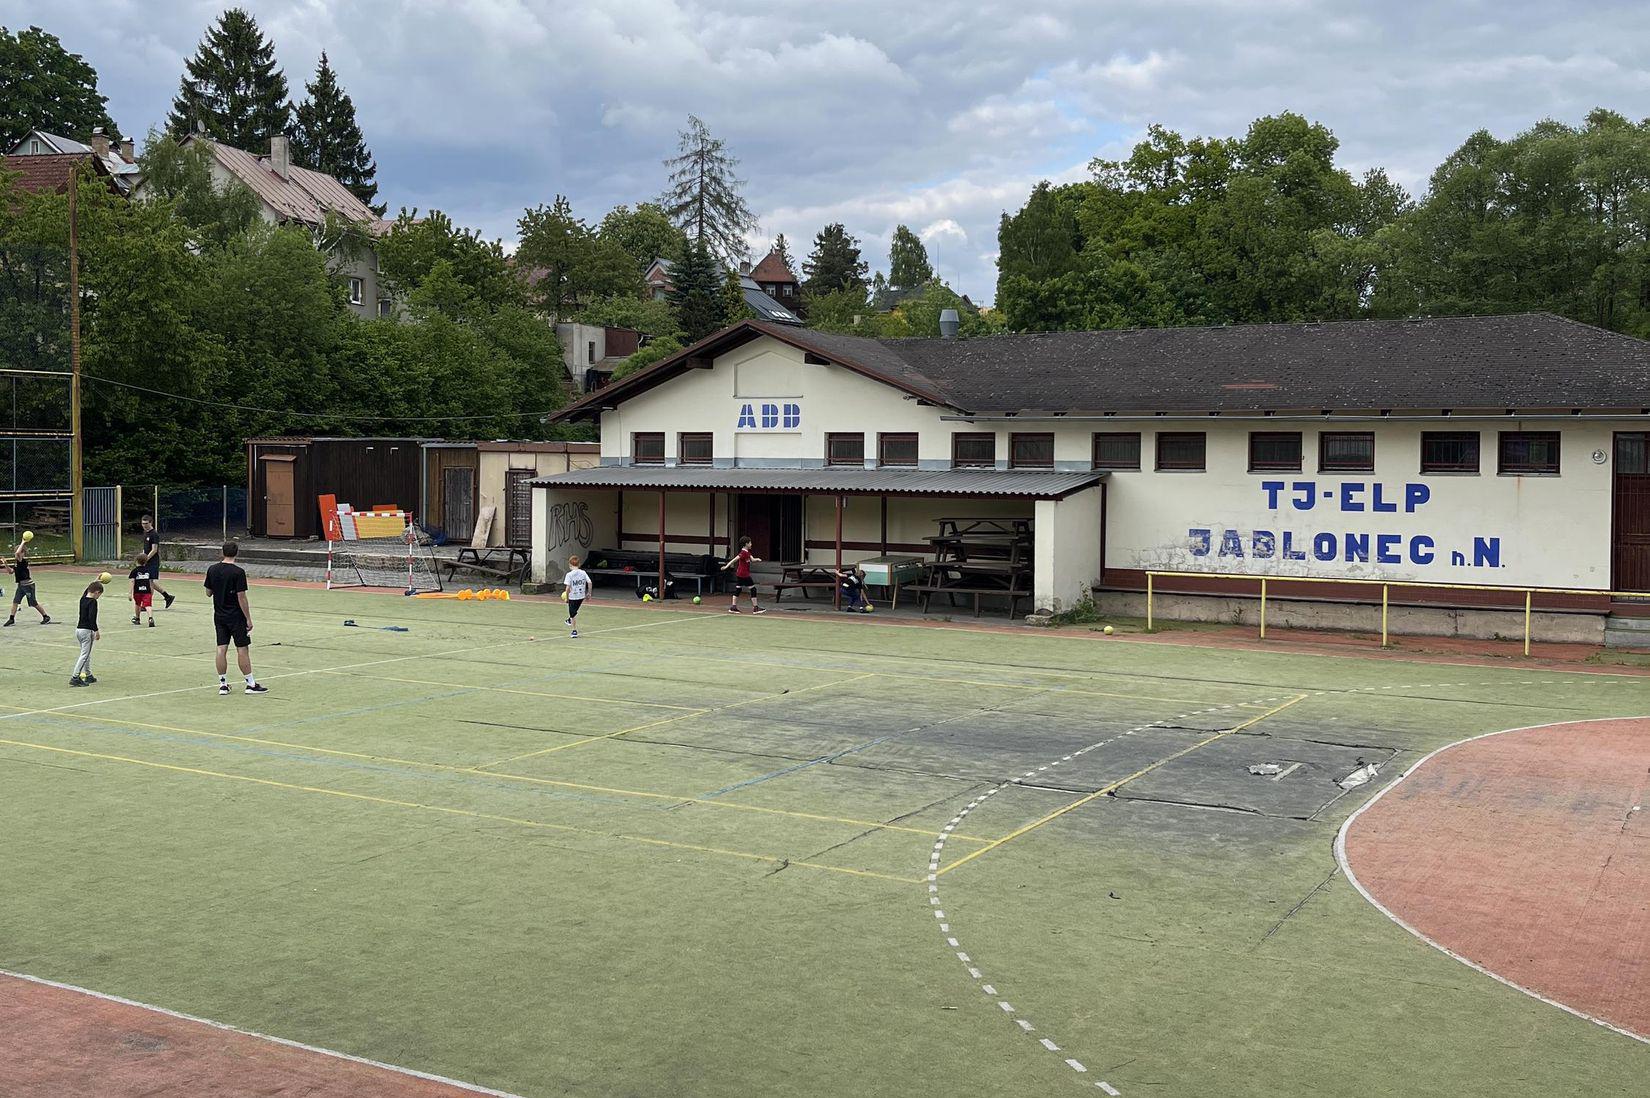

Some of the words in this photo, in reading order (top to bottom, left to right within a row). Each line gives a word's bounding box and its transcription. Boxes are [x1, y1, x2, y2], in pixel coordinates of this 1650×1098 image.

[737, 403, 801, 428] ABB
[1262, 481, 1431, 513] TJ-ELP
[1188, 528, 1435, 566] JABLONEC
